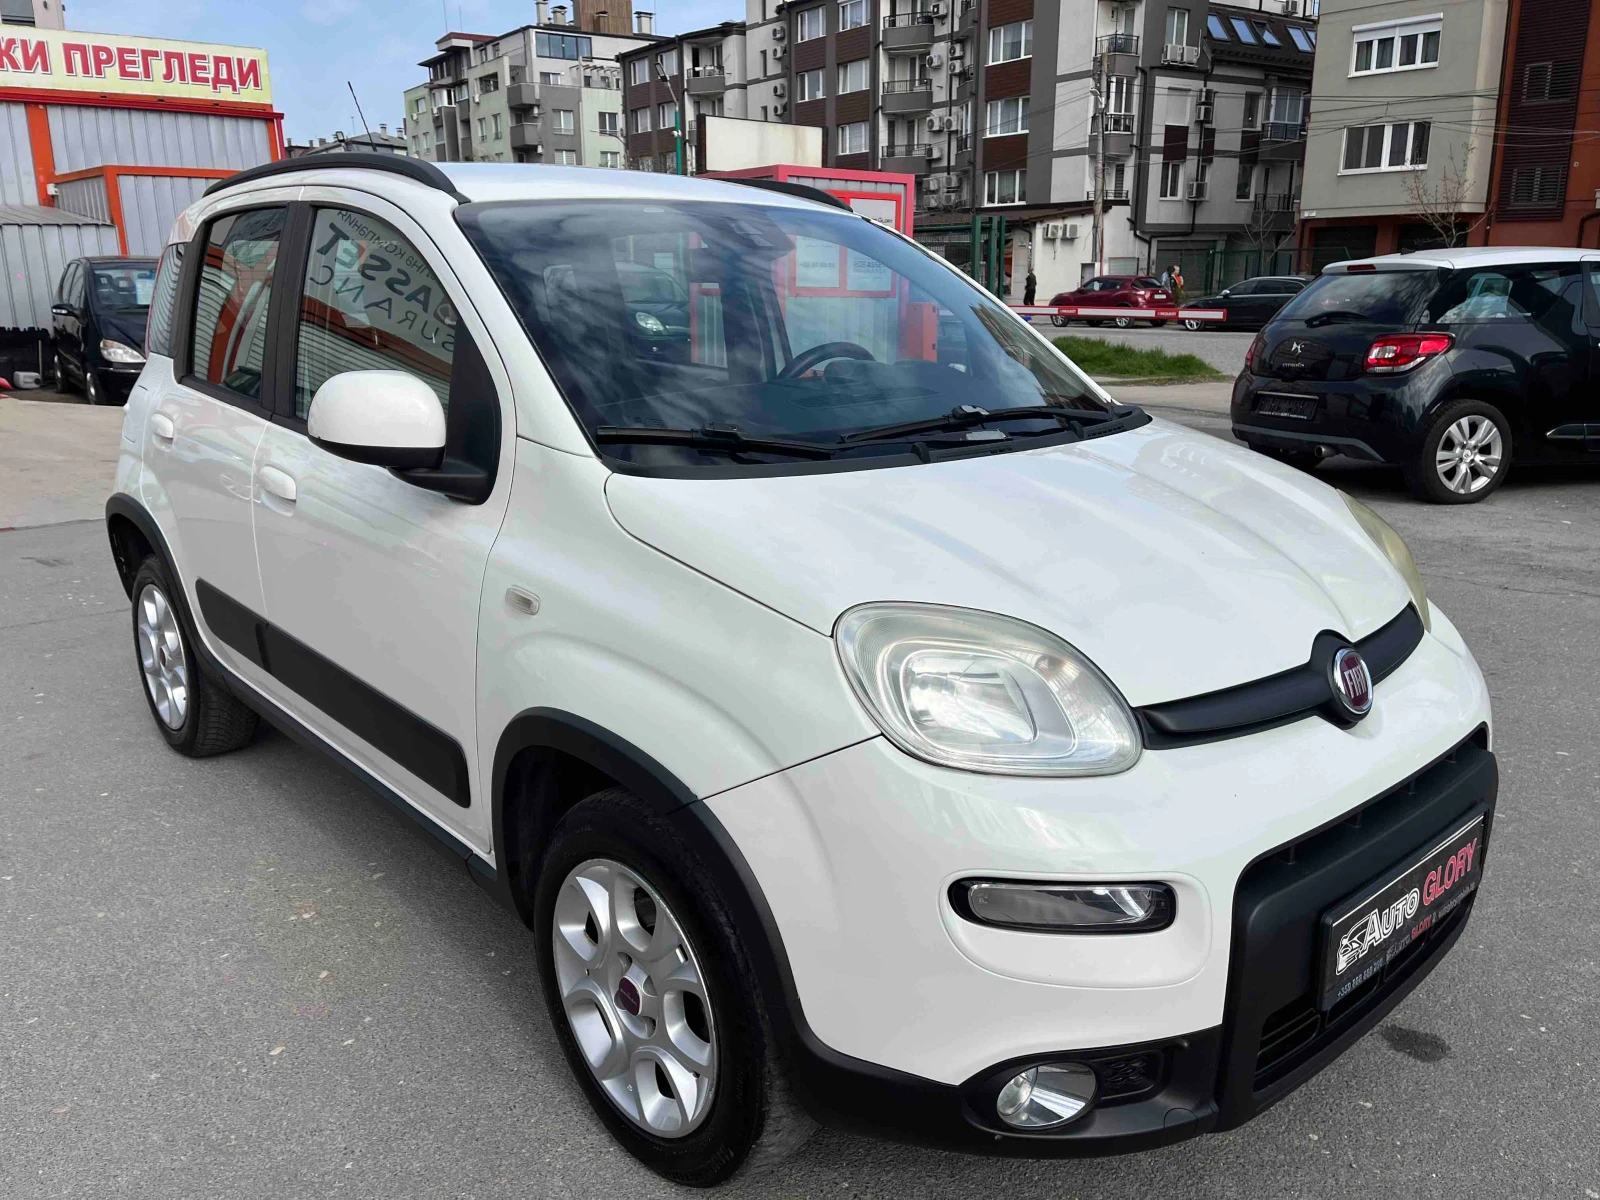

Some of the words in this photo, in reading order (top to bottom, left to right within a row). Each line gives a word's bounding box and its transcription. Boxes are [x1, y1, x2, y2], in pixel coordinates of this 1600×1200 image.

[62, 42, 262, 93] ПРЕГЛЕДИ
[1343, 665, 1368, 699] FIAT
[1359, 887, 1420, 958] AUTO
[1423, 838, 1478, 906] GLORY
